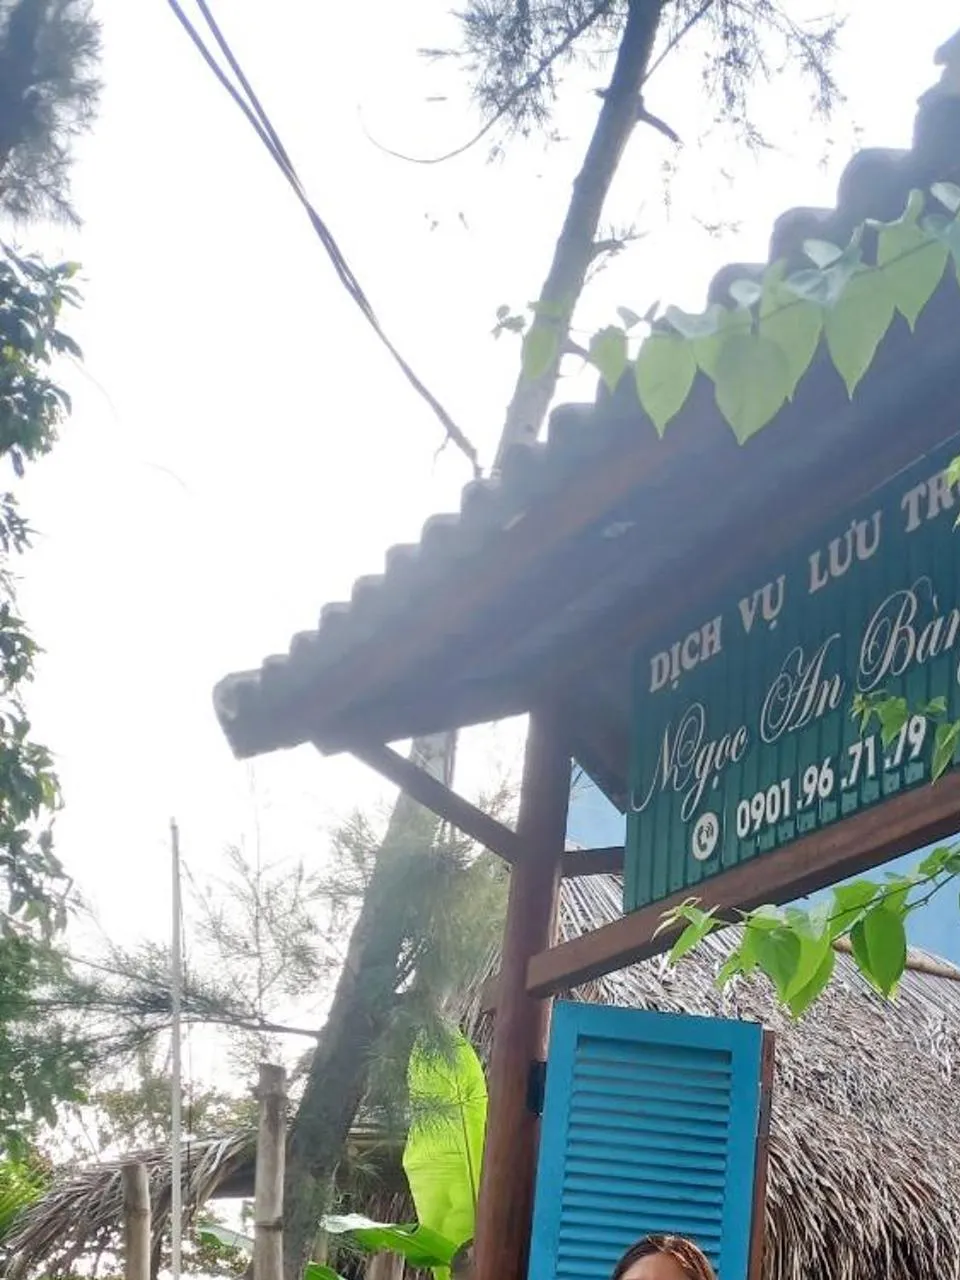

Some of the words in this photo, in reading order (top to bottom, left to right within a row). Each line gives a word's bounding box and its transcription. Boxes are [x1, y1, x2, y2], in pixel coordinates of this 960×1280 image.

[649, 615, 723, 693] DỊCH
[737, 574, 787, 634] VỤ
[808, 509, 883, 594] LƯU
[760, 632, 845, 743] An
